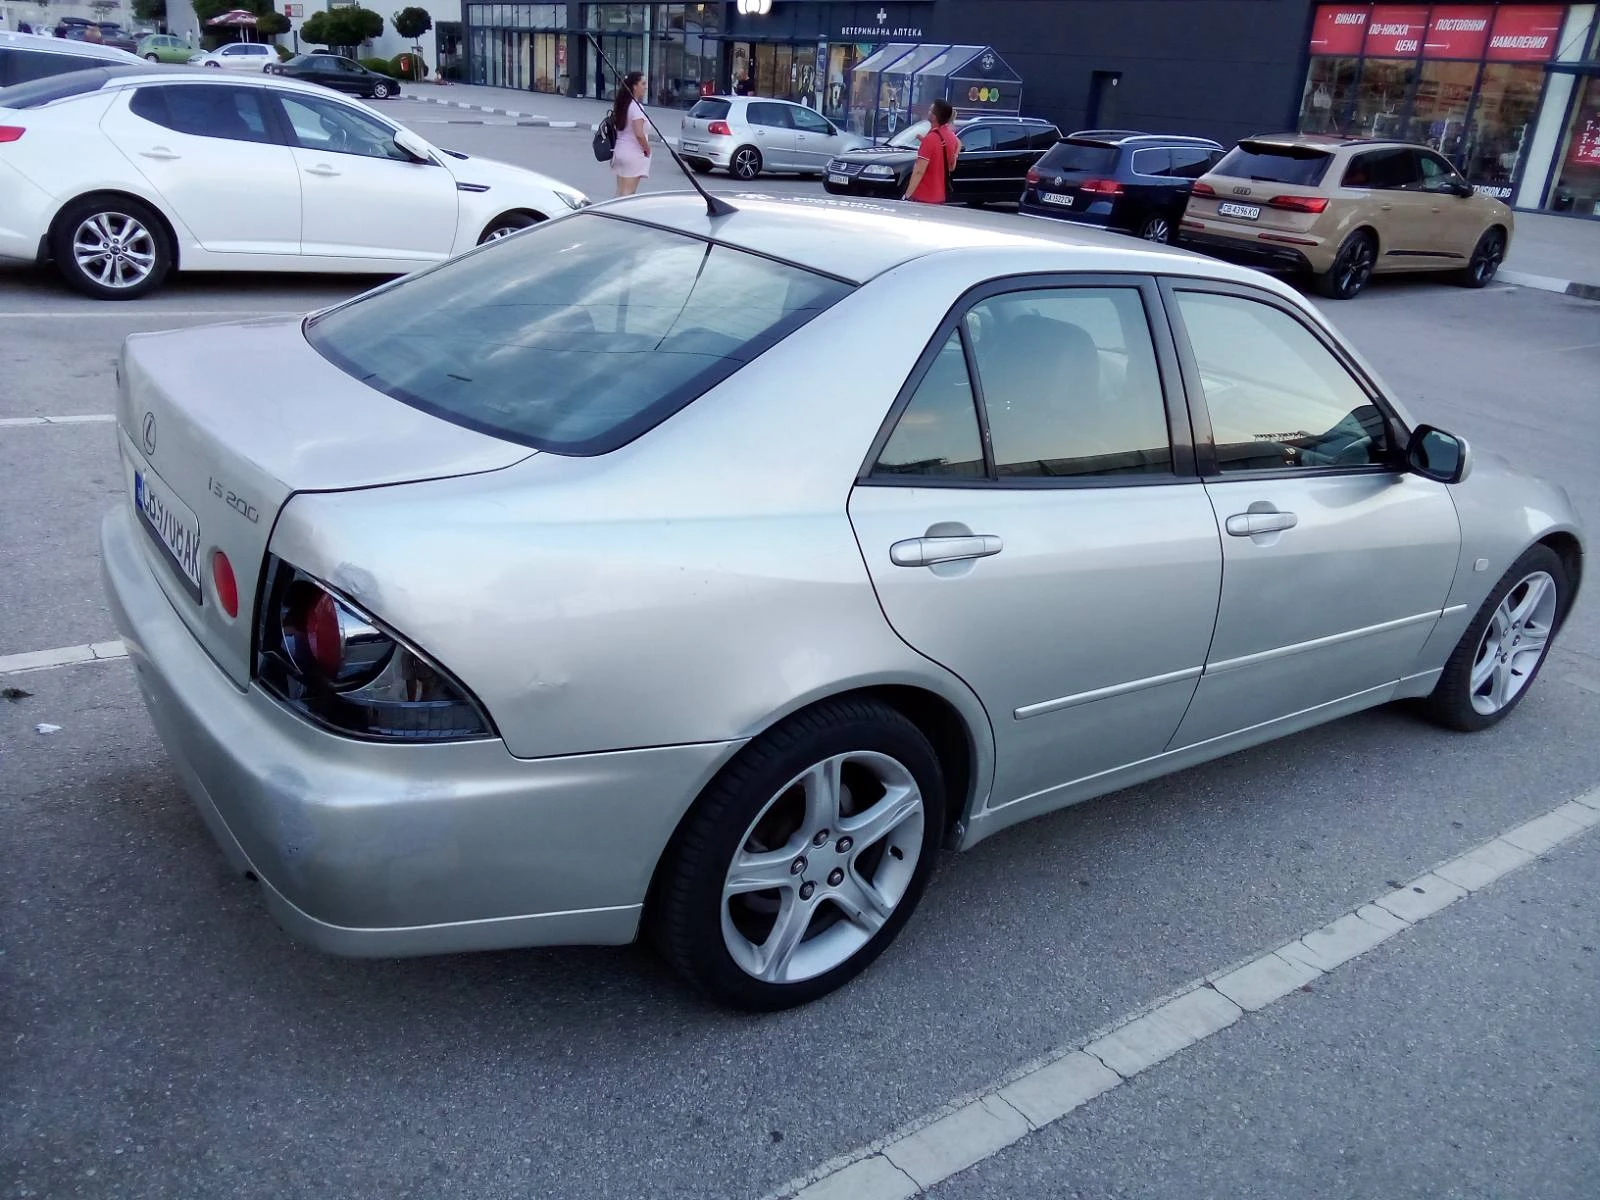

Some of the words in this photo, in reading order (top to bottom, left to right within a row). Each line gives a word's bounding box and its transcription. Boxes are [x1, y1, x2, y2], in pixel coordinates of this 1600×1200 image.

[1334, 13, 1366, 25] ВИНАГИ
[1435, 19, 1487, 31] ПОСТОЯННИ
[893, 28, 923, 37] АПТЕКА
[1394, 39, 1418, 52] ЦЕНА
[1490, 35, 1549, 49] НАМАЛЕНИЯ
